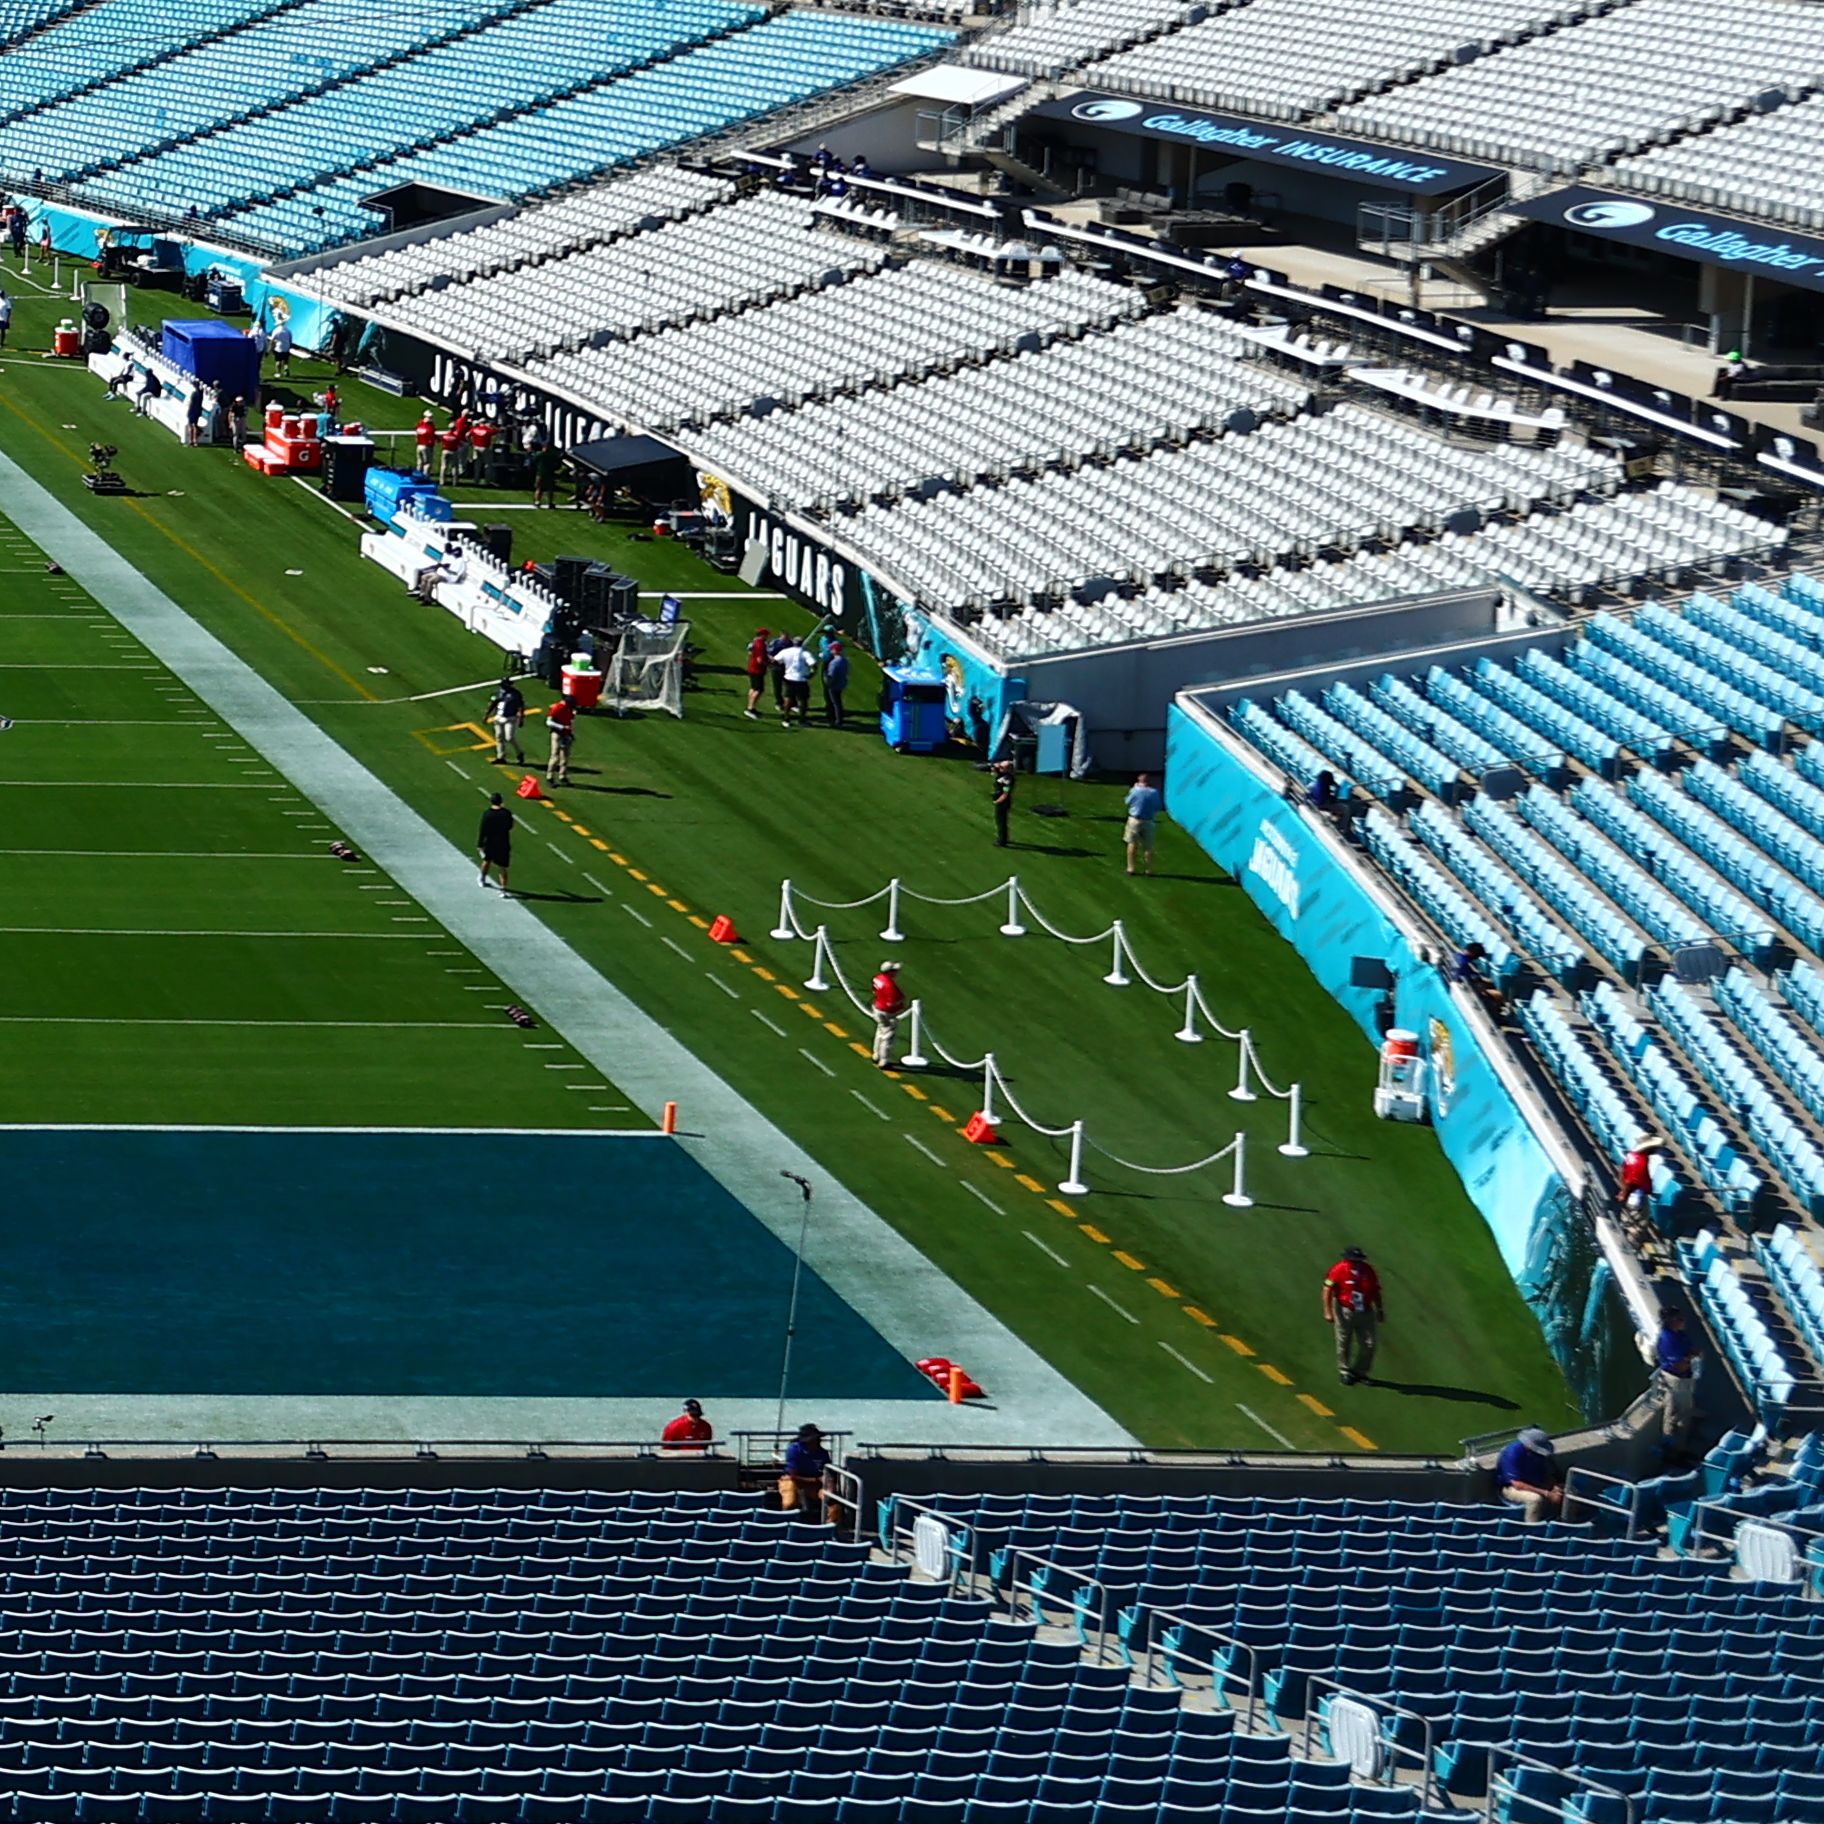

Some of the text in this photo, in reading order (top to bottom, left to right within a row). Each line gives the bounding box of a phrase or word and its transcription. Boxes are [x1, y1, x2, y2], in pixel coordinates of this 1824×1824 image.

[1142, 114, 1448, 183] Gallagher INSURANCE
[1655, 223, 1824, 270] Gallagher
